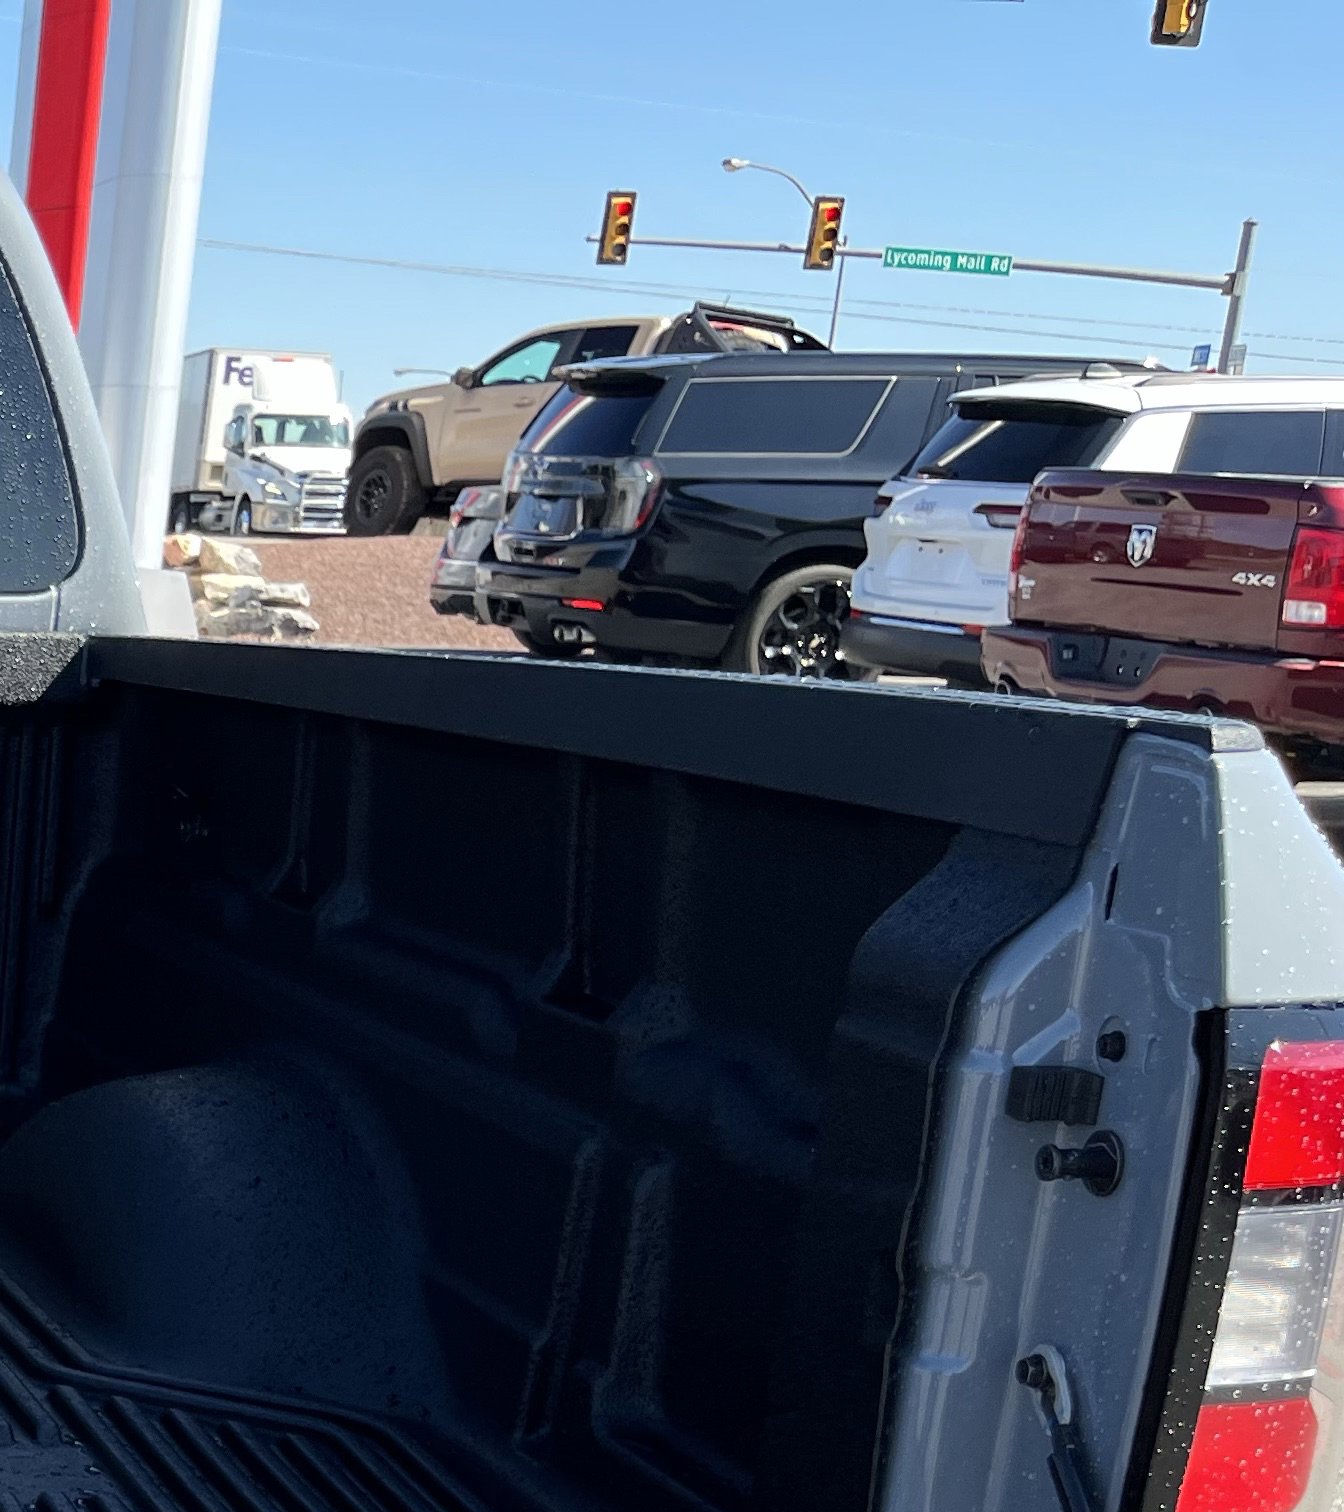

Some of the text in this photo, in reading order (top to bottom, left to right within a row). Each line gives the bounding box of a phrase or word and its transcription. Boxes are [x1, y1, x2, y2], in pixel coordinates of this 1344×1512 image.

[887, 249, 1009, 272] Lycoming Mall Rd
